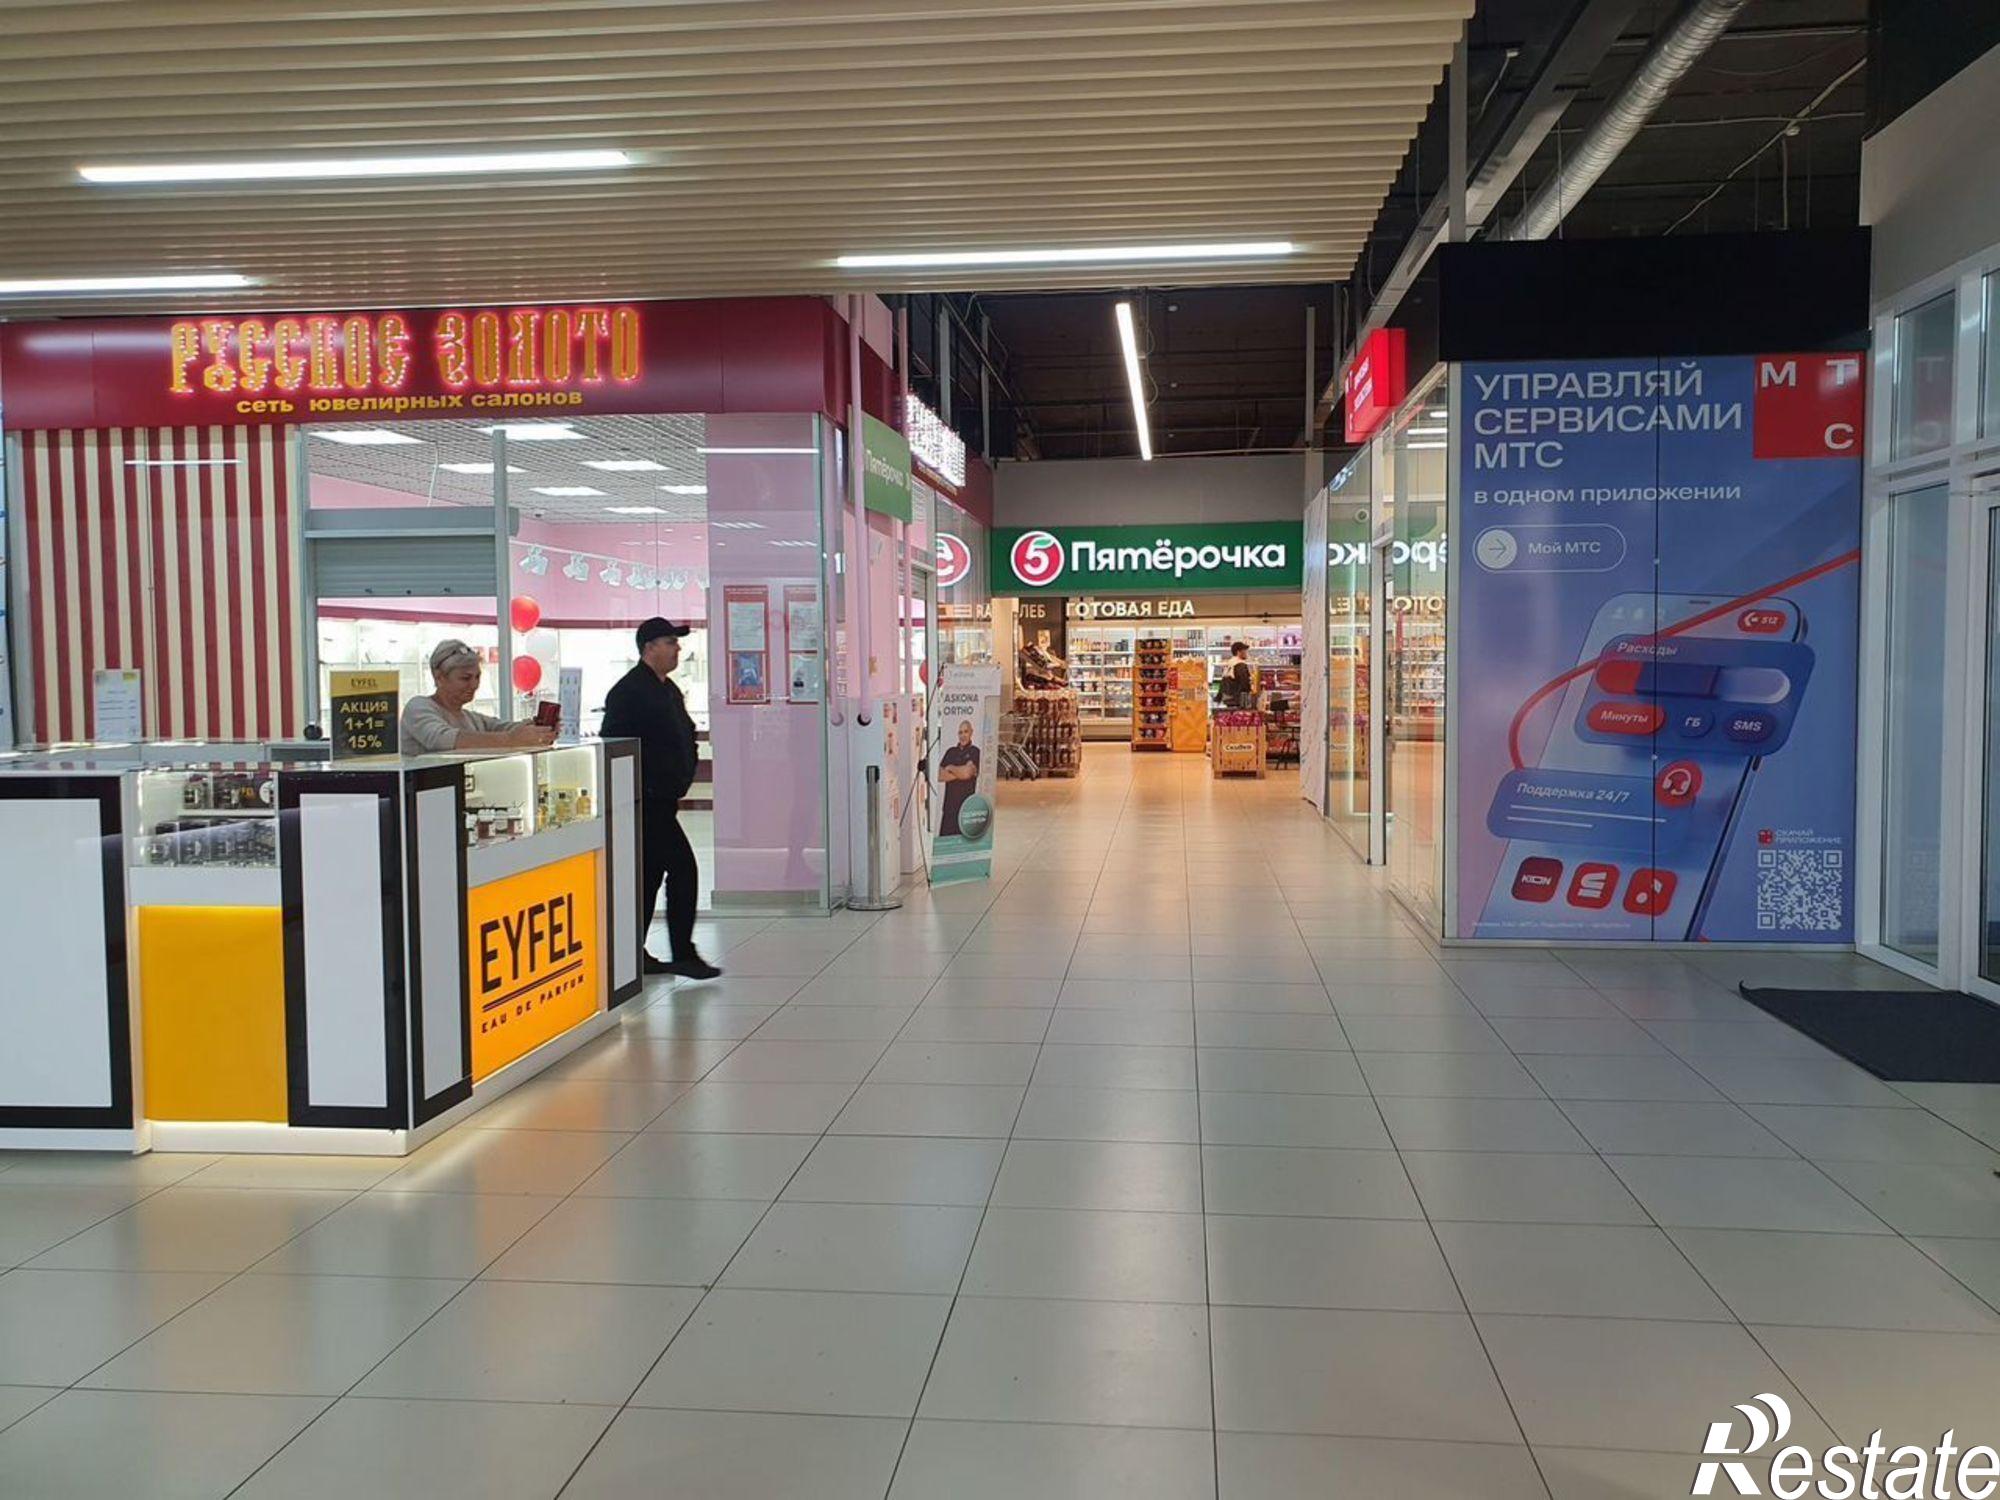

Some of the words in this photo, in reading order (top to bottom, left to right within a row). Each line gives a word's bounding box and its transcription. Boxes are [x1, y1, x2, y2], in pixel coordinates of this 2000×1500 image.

[436, 308, 640, 385] ЗОЛОТО
[1474, 361, 1703, 401] УПРАВЛЯЙ
[236, 398, 294, 414] сеть
[309, 394, 463, 414] ювелирных
[471, 391, 583, 407] салонов
[1474, 402, 1743, 436] СЕРВИСАМИ
[1474, 440, 1564, 470] МТС
[1474, 490, 1487, 503] в
[1494, 488, 1575, 506] одном
[1581, 486, 1742, 505] приложении
[1071, 538, 1286, 577] Пятёрочка
[1528, 541, 1562, 555] Мой
[1564, 540, 1602, 555] МТС
[1019, 604, 1047, 618] ЛЕБ
[1066, 600, 1152, 617] ГОТОВАЯ
[1158, 600, 1195, 617] ЕДА
[1617, 641, 1678, 658] Расходы
[340, 700, 389, 714] АКЦИЯ
[1600, 709, 1649, 725] Минуты
[1733, 719, 1762, 733] SMS
[348, 735, 383, 749] 15%
[1517, 781, 1596, 801] Поддержка
[1596, 788, 1630, 804] 24/7
[480, 892, 583, 995] EYFEL
[481, 1012, 508, 1034] EAU
[516, 999, 533, 1016] DE
[540, 976, 584, 1003] PARFUM
